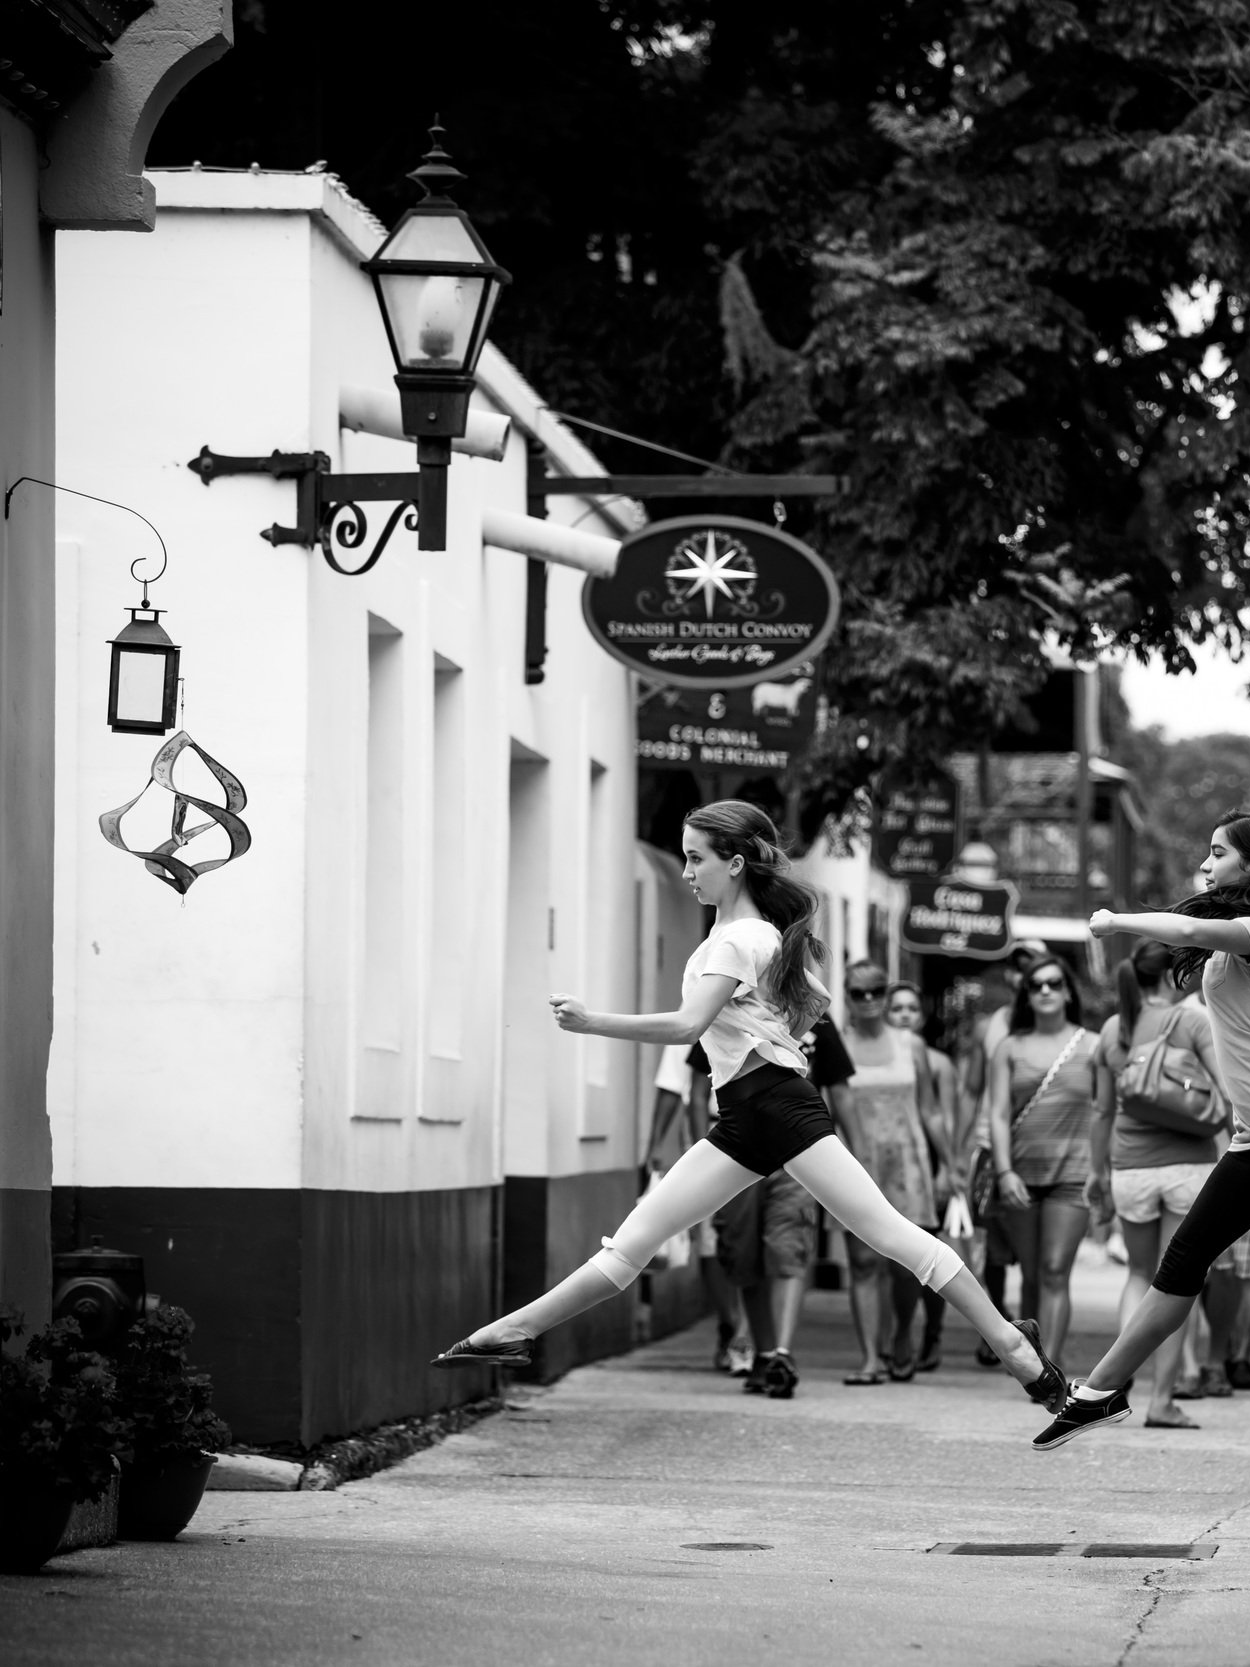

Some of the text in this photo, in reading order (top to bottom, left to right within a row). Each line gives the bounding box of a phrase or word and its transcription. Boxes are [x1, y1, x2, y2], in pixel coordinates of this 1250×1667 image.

[607, 620, 814, 638] SPANISH DUTCH CONVOY
[708, 692, 727, 720] &
[669, 724, 762, 749] COLONIAL
[700, 745, 790, 769] MERCHANT
